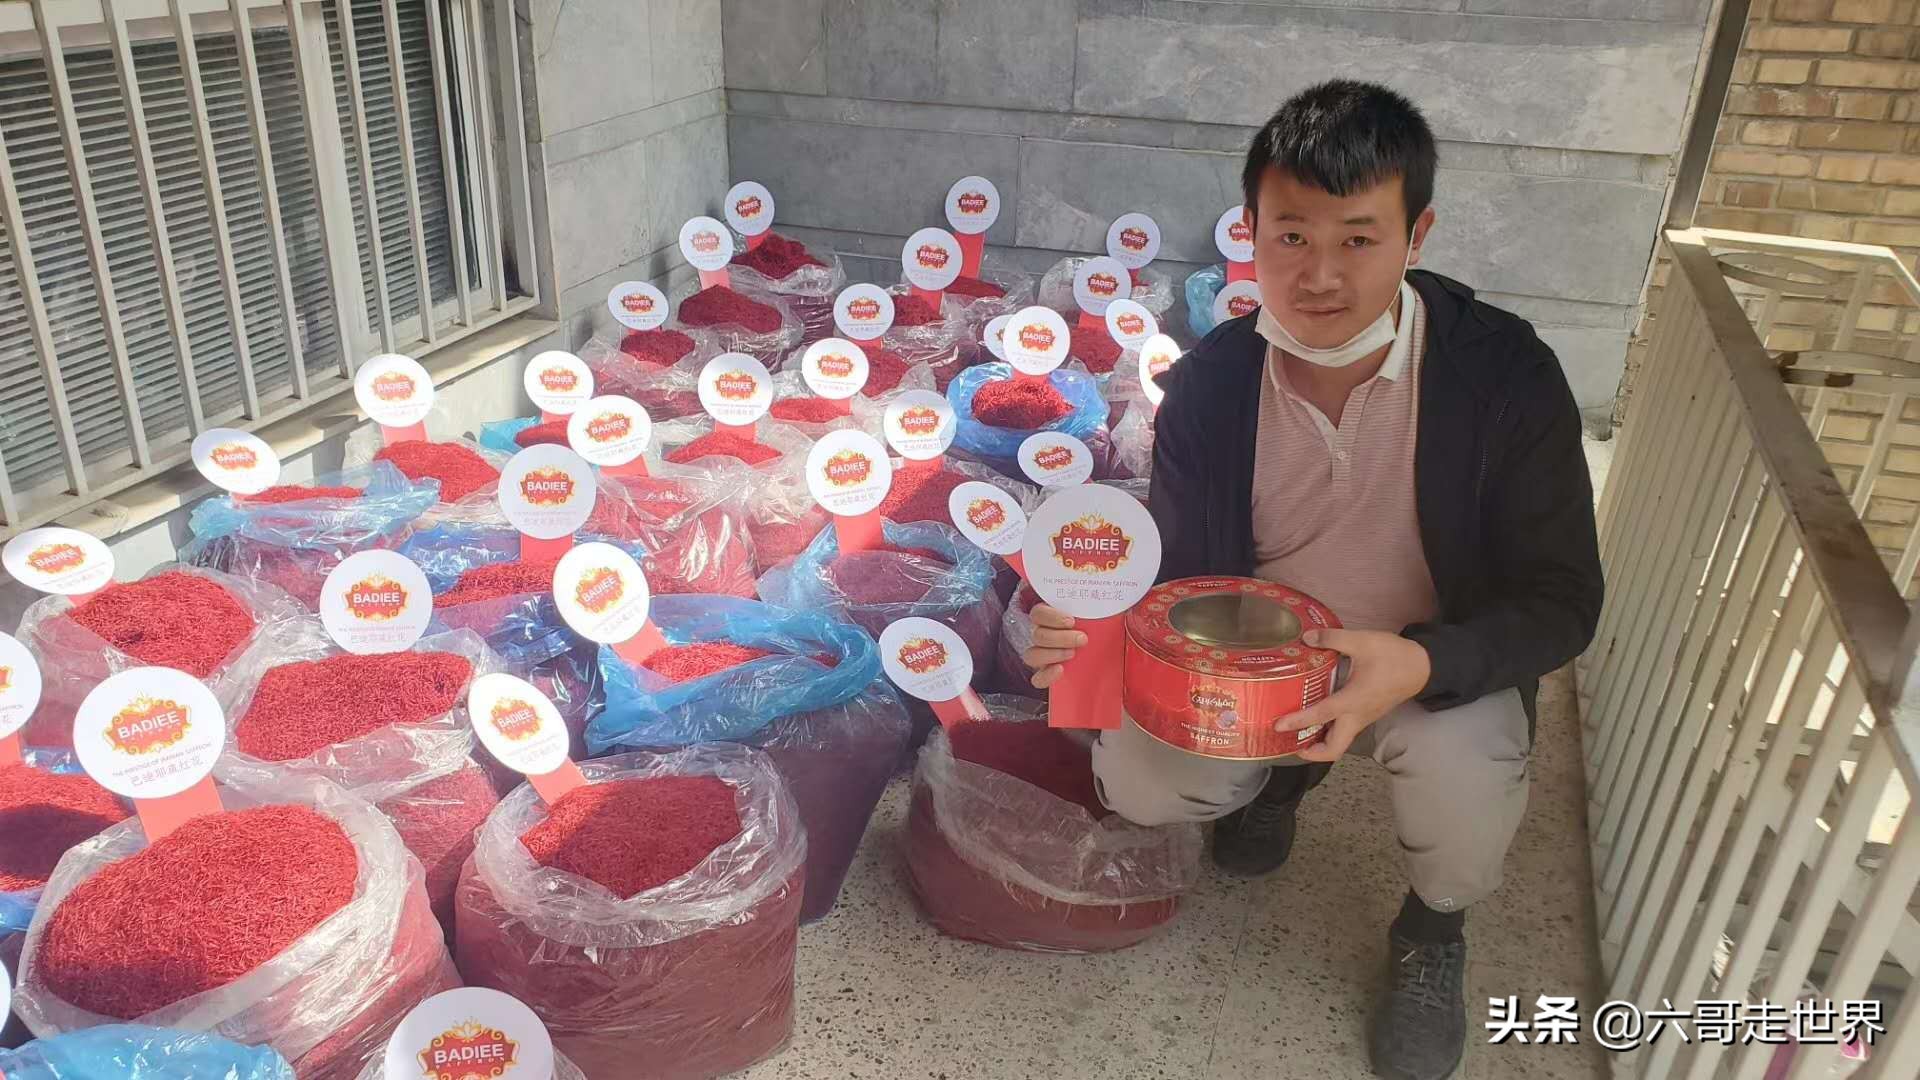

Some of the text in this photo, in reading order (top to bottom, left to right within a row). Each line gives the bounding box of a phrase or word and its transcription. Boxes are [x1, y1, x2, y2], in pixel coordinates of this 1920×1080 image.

[960, 199, 986, 208] BADIEE
[1122, 233, 1146, 246] BADIEE
[920, 250, 947, 262] BADIEE
[1090, 278, 1114, 291] BADIEE
[719, 381, 752, 391] BADIEE
[591, 419, 627, 435] BADIEE
[903, 415, 934, 426] BADIEE
[1037, 453, 1067, 465] BADIEE
[830, 461, 866, 475] BADIEE
[526, 481, 568, 491] BADIEE
[971, 504, 998, 525] BADIEE
[1062, 537, 1120, 551] BADIEE
[582, 576, 619, 602] BADIEE
[352, 592, 401, 604] BADIEE
[904, 644, 943, 664] BADIEE
[118, 711, 180, 739] BADIEE
[497, 708, 533, 729] BADIEE
[1190, 732, 1230, 746] SAFFRON
[434, 1043, 504, 1064] BADIEE
